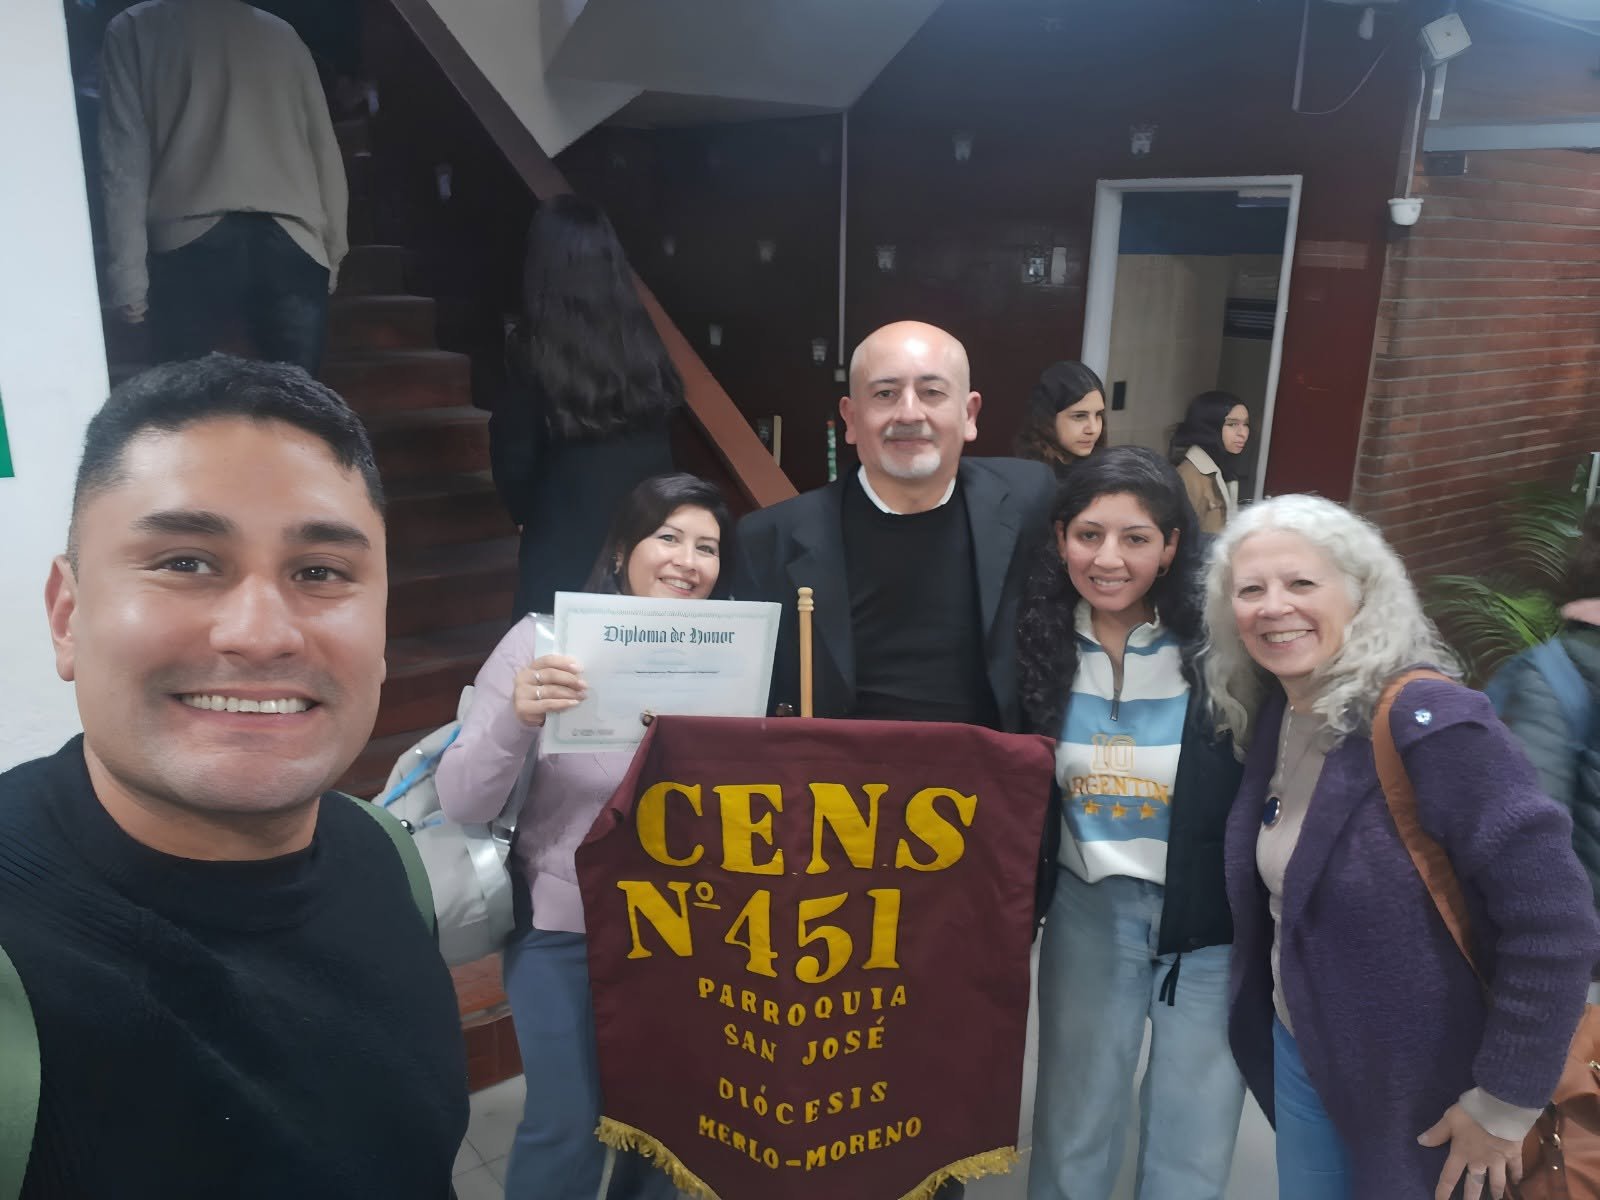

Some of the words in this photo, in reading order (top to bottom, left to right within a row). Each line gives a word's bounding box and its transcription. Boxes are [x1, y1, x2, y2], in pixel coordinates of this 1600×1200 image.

[603, 625, 667, 647] Diploma
[670, 626, 686, 643] de
[689, 627, 735, 645] Honor
[1092, 733, 1136, 772] 10
[635, 781, 978, 875] CENS
[724, 888, 902, 984] 451
[698, 976, 907, 1027] PARROQUIA
[723, 1023, 777, 1063] SAN
[801, 1015, 885, 1066] JOSÉ
[718, 1076, 888, 1125] DIÓCESIS
